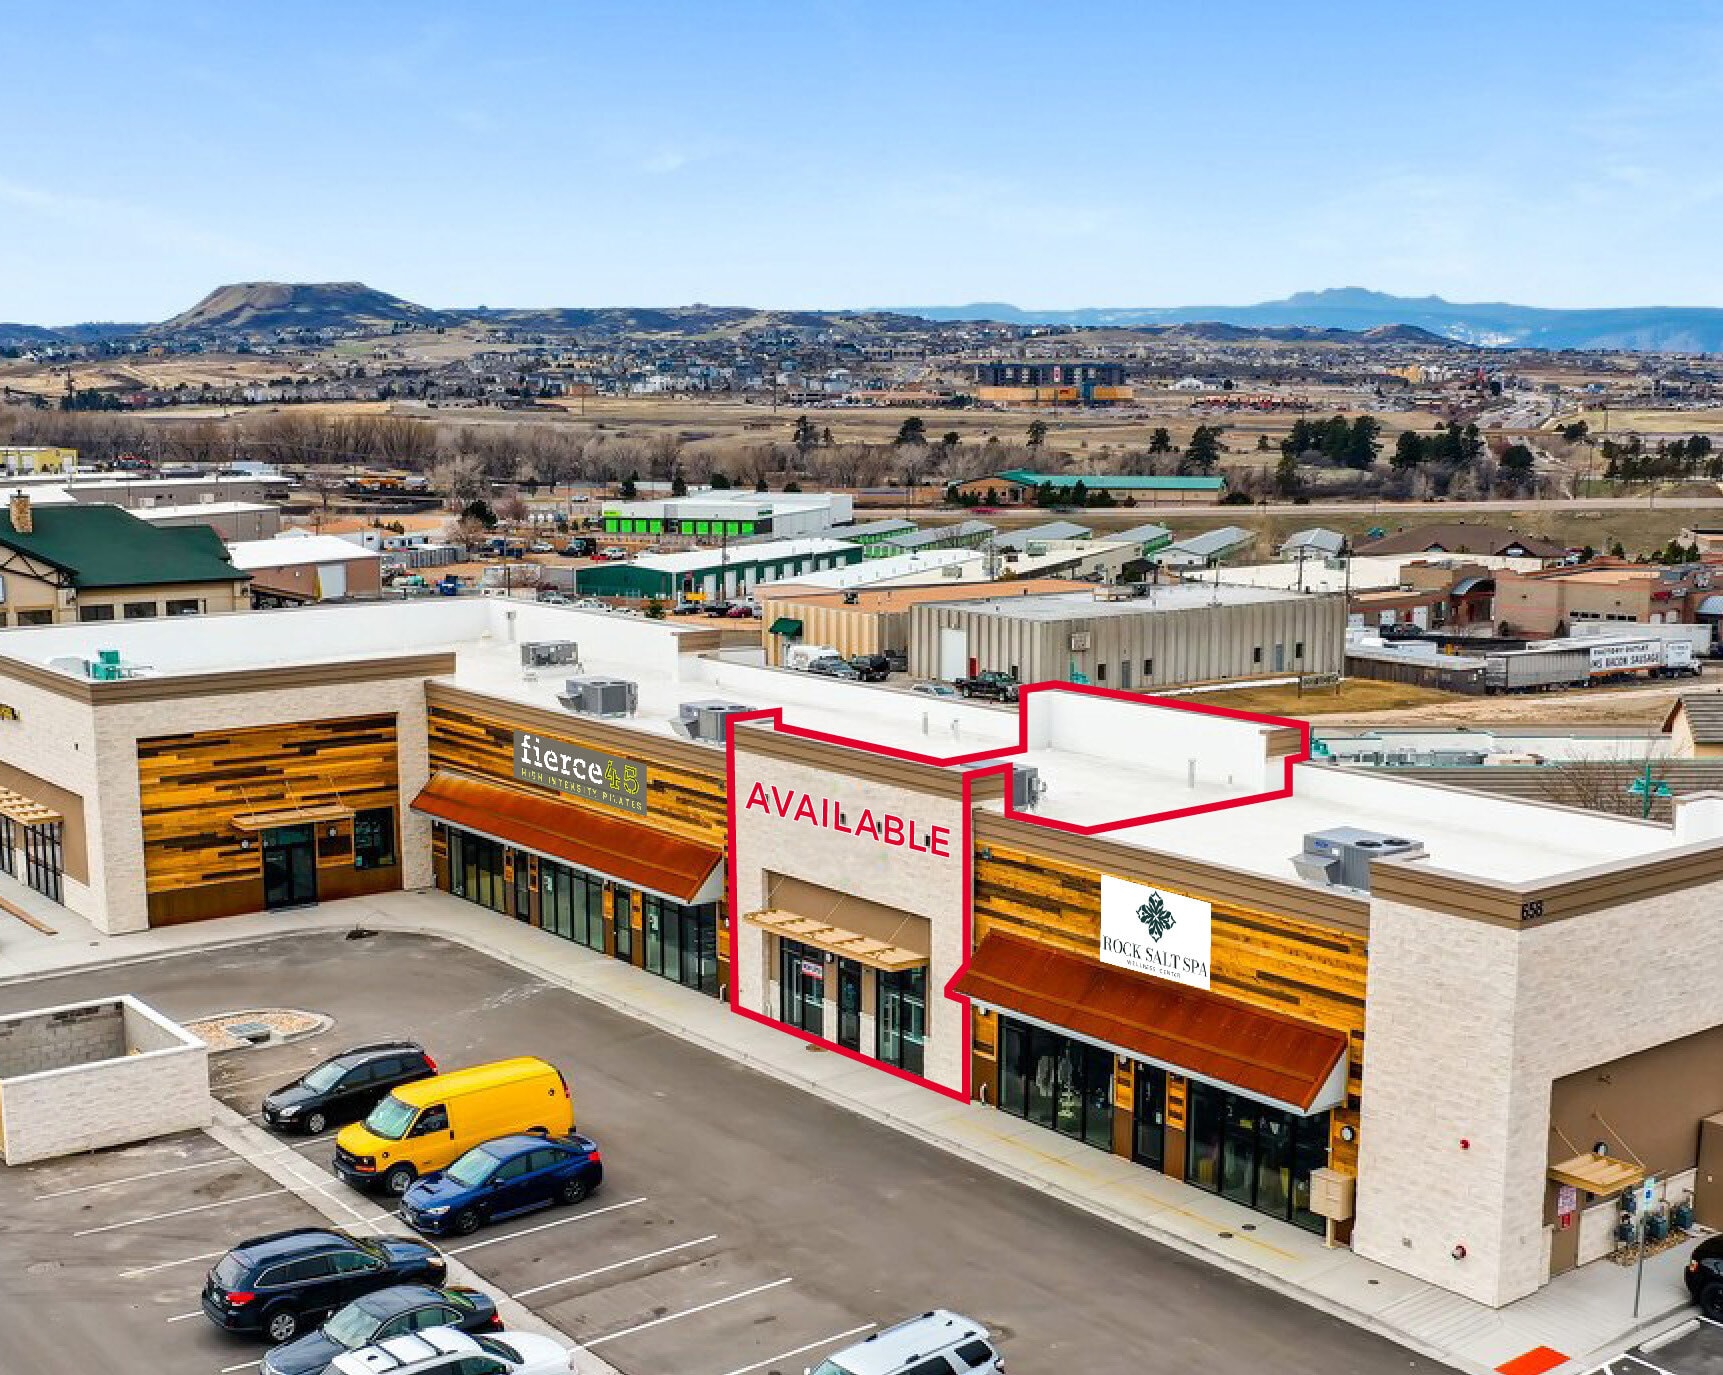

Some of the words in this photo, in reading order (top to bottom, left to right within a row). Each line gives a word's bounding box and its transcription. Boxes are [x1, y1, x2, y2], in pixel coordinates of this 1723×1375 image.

[521, 767, 543, 782] HIGH
[548, 776, 597, 799] INTENSITY
[602, 791, 642, 811] PILATES
[1522, 901, 1542, 920] 658
[1103, 935, 1142, 960] ROCK
[1145, 947, 1181, 969] SALT
[1182, 957, 1207, 978] SPA
[1126, 960, 1156, 972] WELLNESS
[1159, 968, 1181, 979] CENTER
